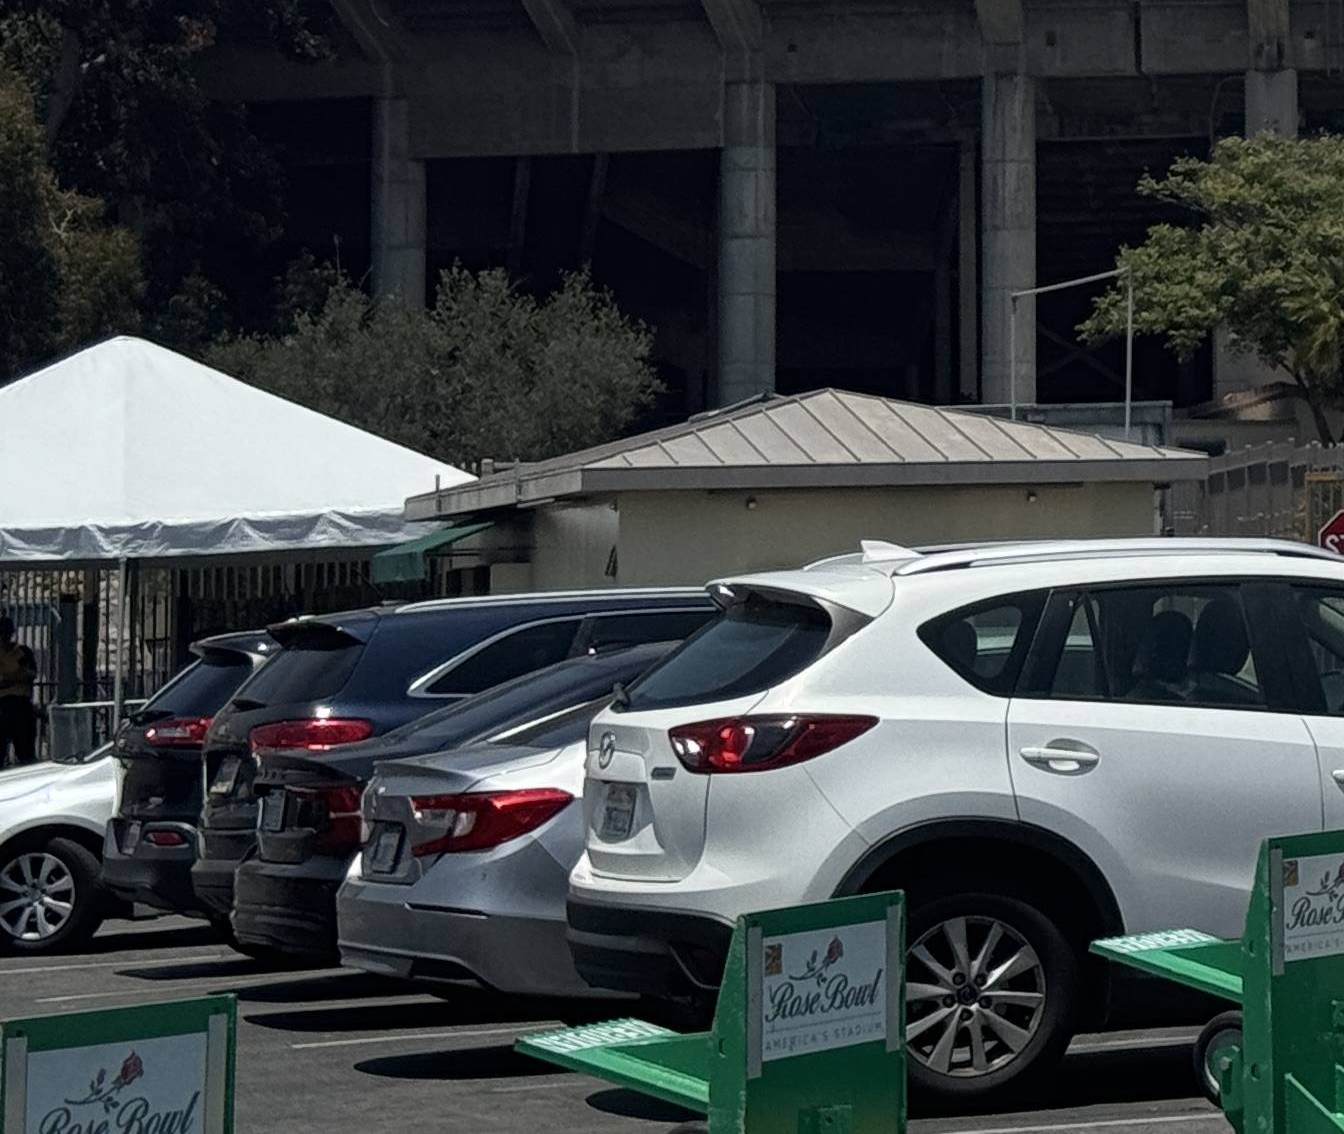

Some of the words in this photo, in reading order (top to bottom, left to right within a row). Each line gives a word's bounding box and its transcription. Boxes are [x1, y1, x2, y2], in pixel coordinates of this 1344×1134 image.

[1286, 896, 1333, 930] Rose
[764, 982, 821, 1023] Rose
[820, 968, 883, 1013] Bowl
